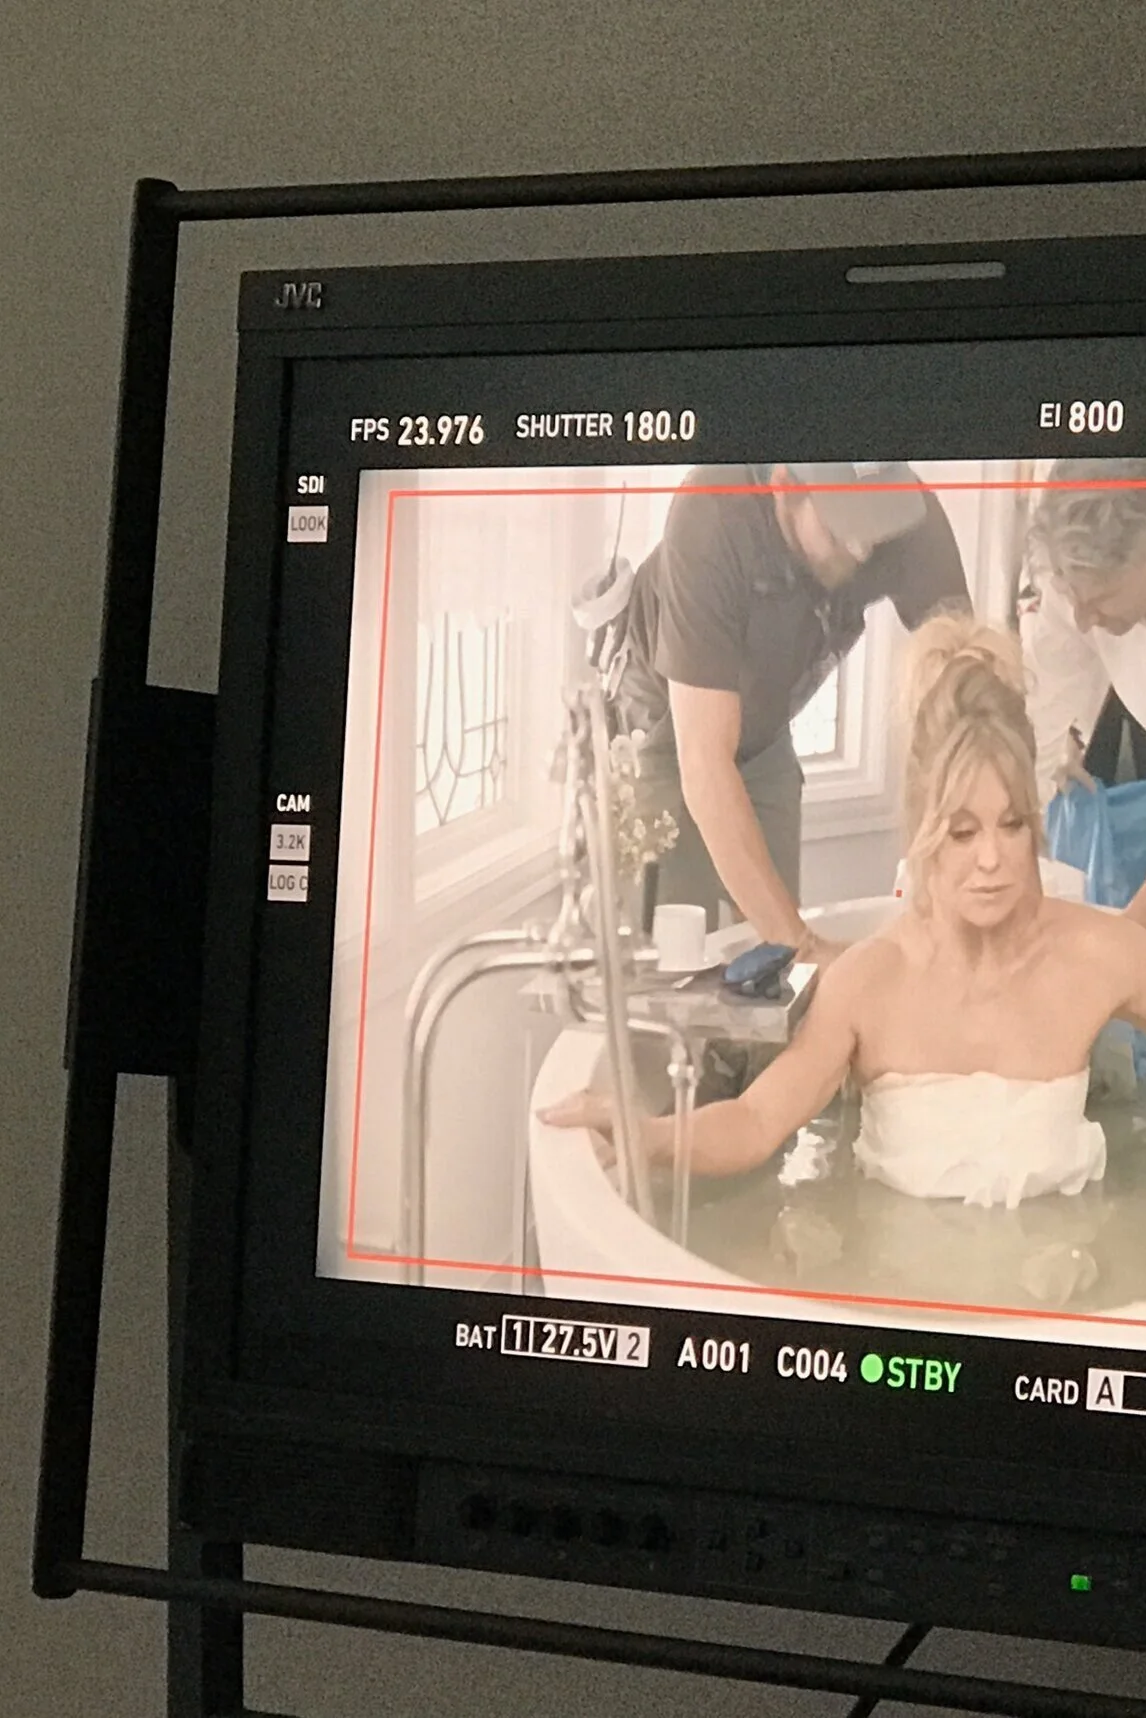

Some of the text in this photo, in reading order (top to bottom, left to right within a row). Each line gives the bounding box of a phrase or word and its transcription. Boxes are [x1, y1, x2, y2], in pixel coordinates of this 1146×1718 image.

[275, 282, 322, 309] JVC
[350, 415, 484, 446] FPS 23.976
[516, 410, 696, 441] SHUTTER 180.0
[1039, 401, 1124, 433] EI 800
[297, 475, 325, 494] SDI
[291, 515, 326, 532] LOOK
[276, 793, 311, 813] CAM
[276, 834, 306, 850] 3.2K
[269, 874, 296, 890] LOG
[455, 1323, 497, 1350] BAT
[541, 1323, 618, 1359] 27.5V
[626, 1332, 641, 1361] 2
[776, 1347, 962, 1393] C004 STBY
[1014, 1376, 1080, 1405] CARD
[1095, 1375, 1116, 1408] A
